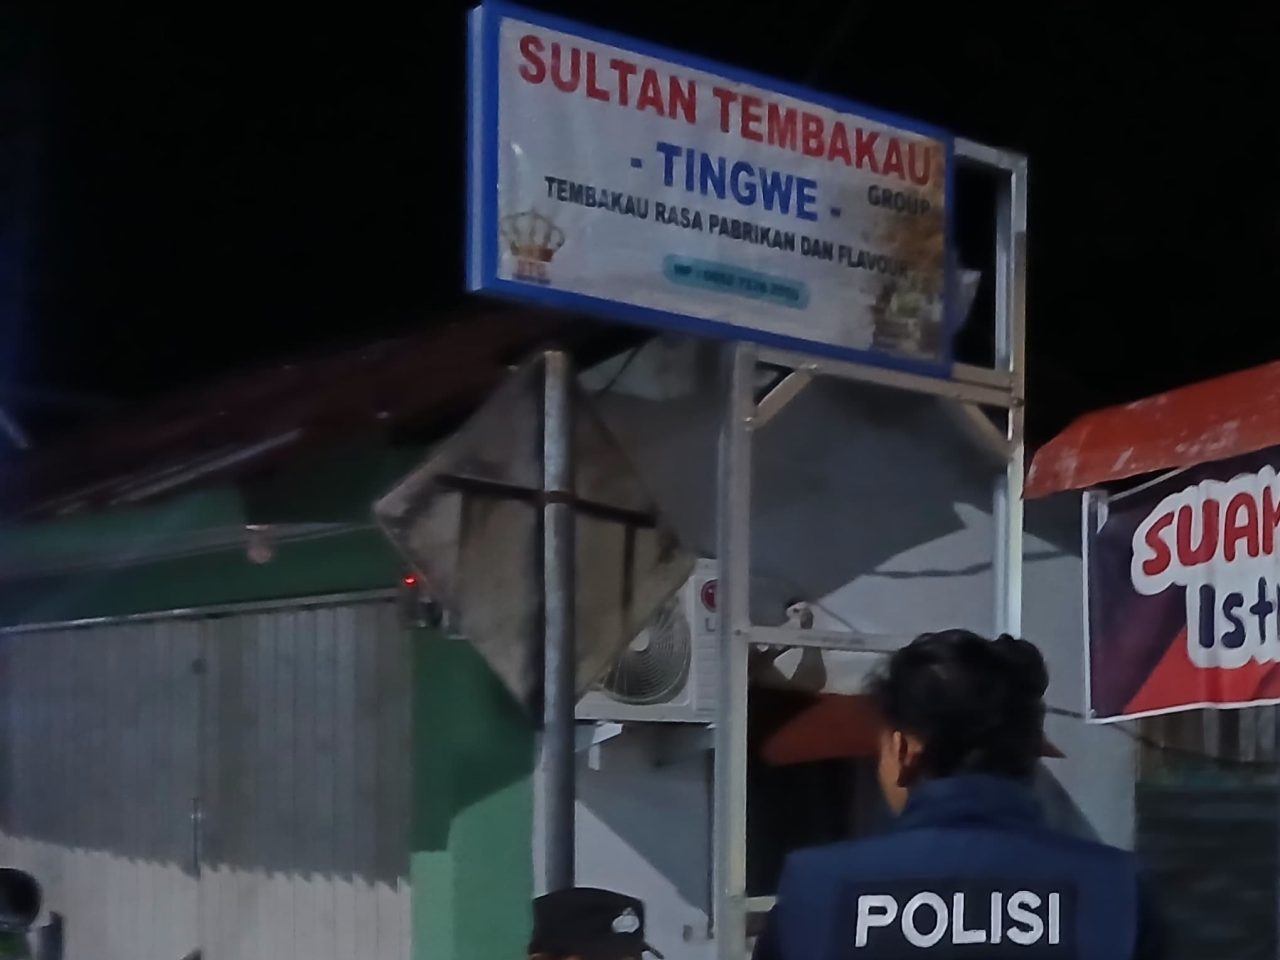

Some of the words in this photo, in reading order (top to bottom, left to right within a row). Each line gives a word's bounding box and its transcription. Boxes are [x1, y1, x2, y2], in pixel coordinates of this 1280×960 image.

[519, 34, 696, 125] SULTAN
[712, 86, 931, 185] TEMBAKAU
[544, 175, 649, 219] TEMBAKAU
[655, 202, 703, 231] RASA
[709, 214, 796, 252] PABRIKAN
[800, 235, 834, 261] DAN
[656, 141, 819, 221] TINGWE
[867, 184, 931, 215] GROUP
[855, 889, 1061, 948] POLISI
